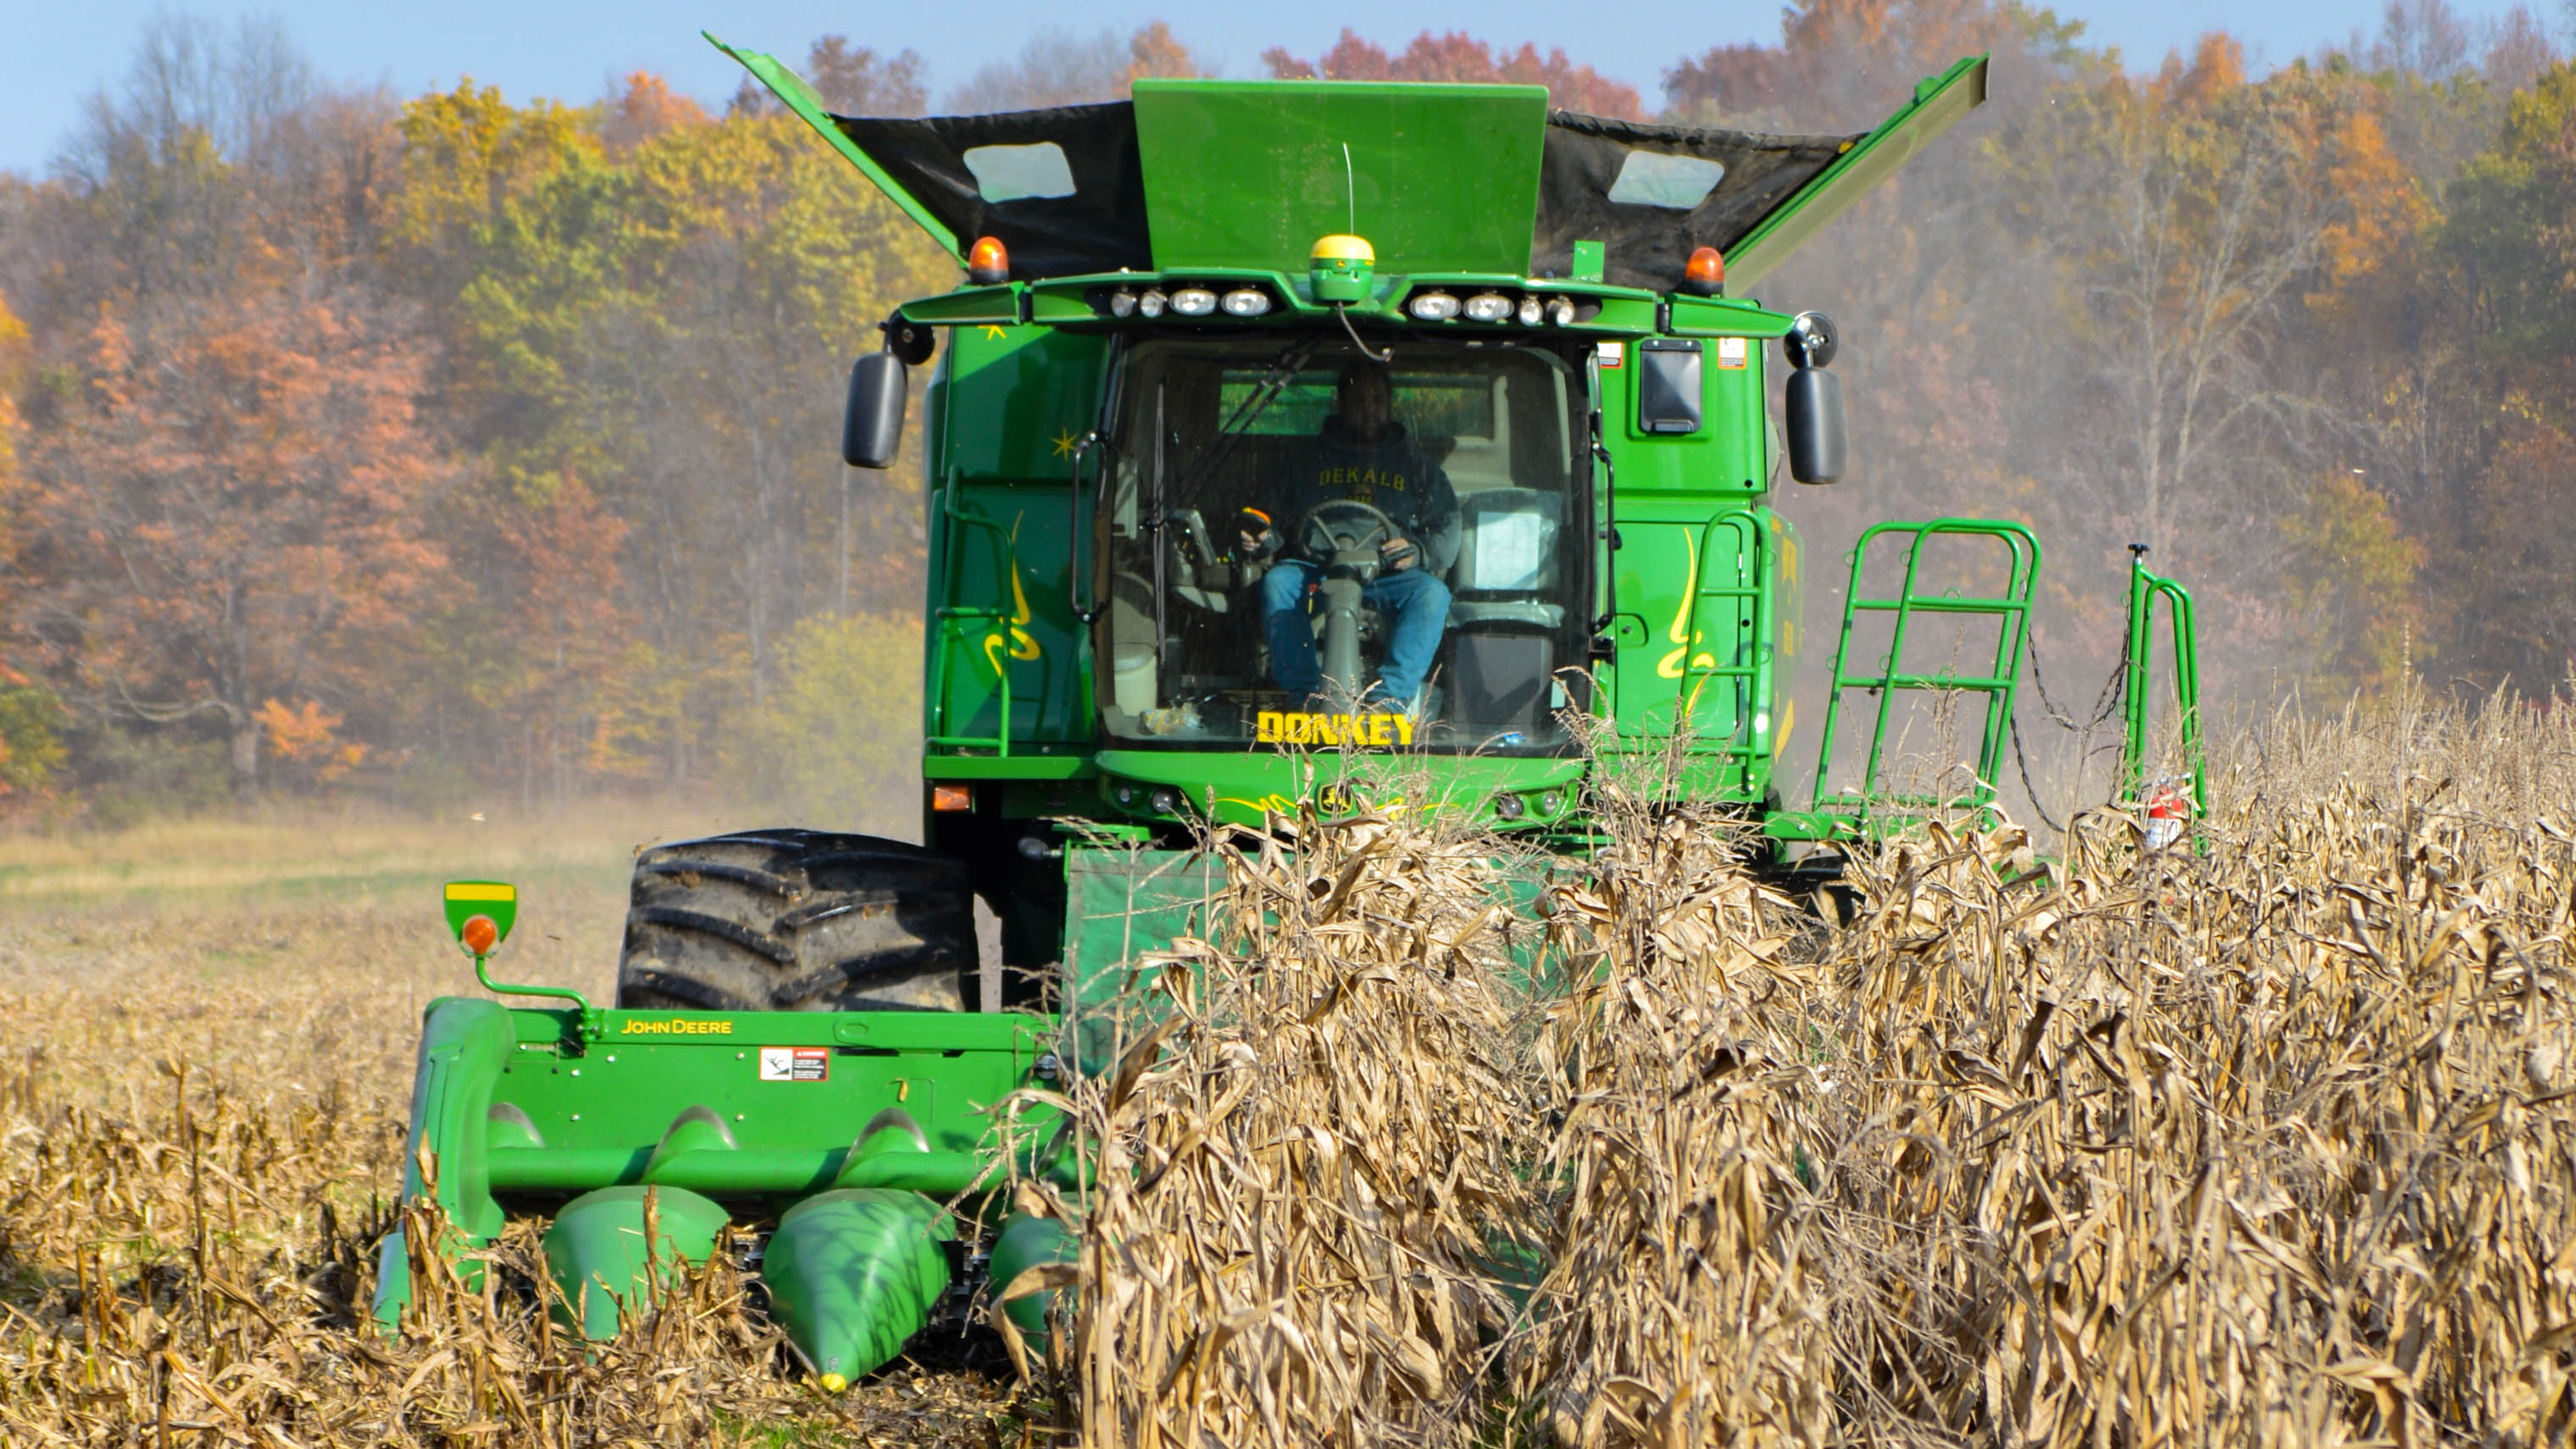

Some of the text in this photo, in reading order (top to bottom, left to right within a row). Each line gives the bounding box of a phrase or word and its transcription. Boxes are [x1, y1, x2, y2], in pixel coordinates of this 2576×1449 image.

[1319, 468, 1405, 491] DEKALB
[1257, 712, 1417, 745] DONKEY
[621, 1019, 732, 1034] JOHN DEERE
